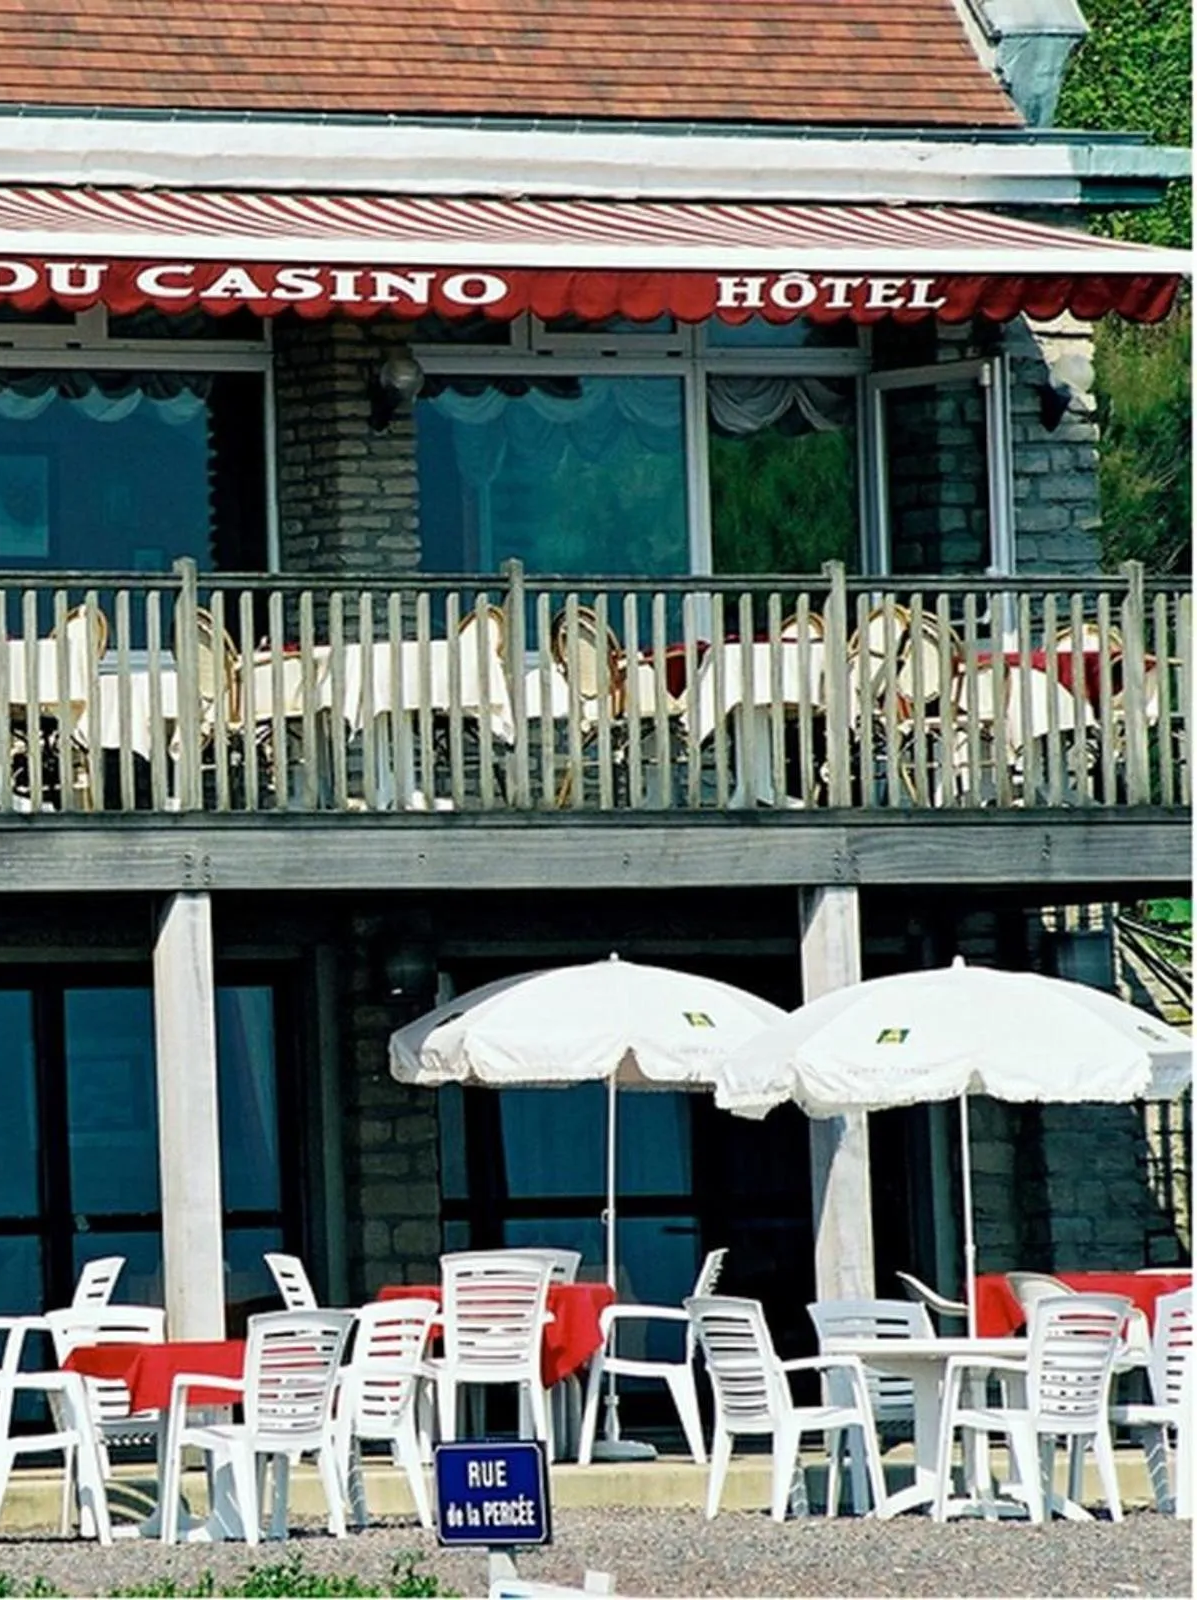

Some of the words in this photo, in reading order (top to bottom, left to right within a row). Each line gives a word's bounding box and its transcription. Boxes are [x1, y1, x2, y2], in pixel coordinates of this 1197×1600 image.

[136, 264, 508, 305] CASINO
[716, 271, 948, 309] HÔTEL
[468, 1460, 507, 1488] RUE
[447, 1502, 463, 1527] de
[466, 1502, 480, 1527] la
[483, 1494, 536, 1527] PERCÉE
